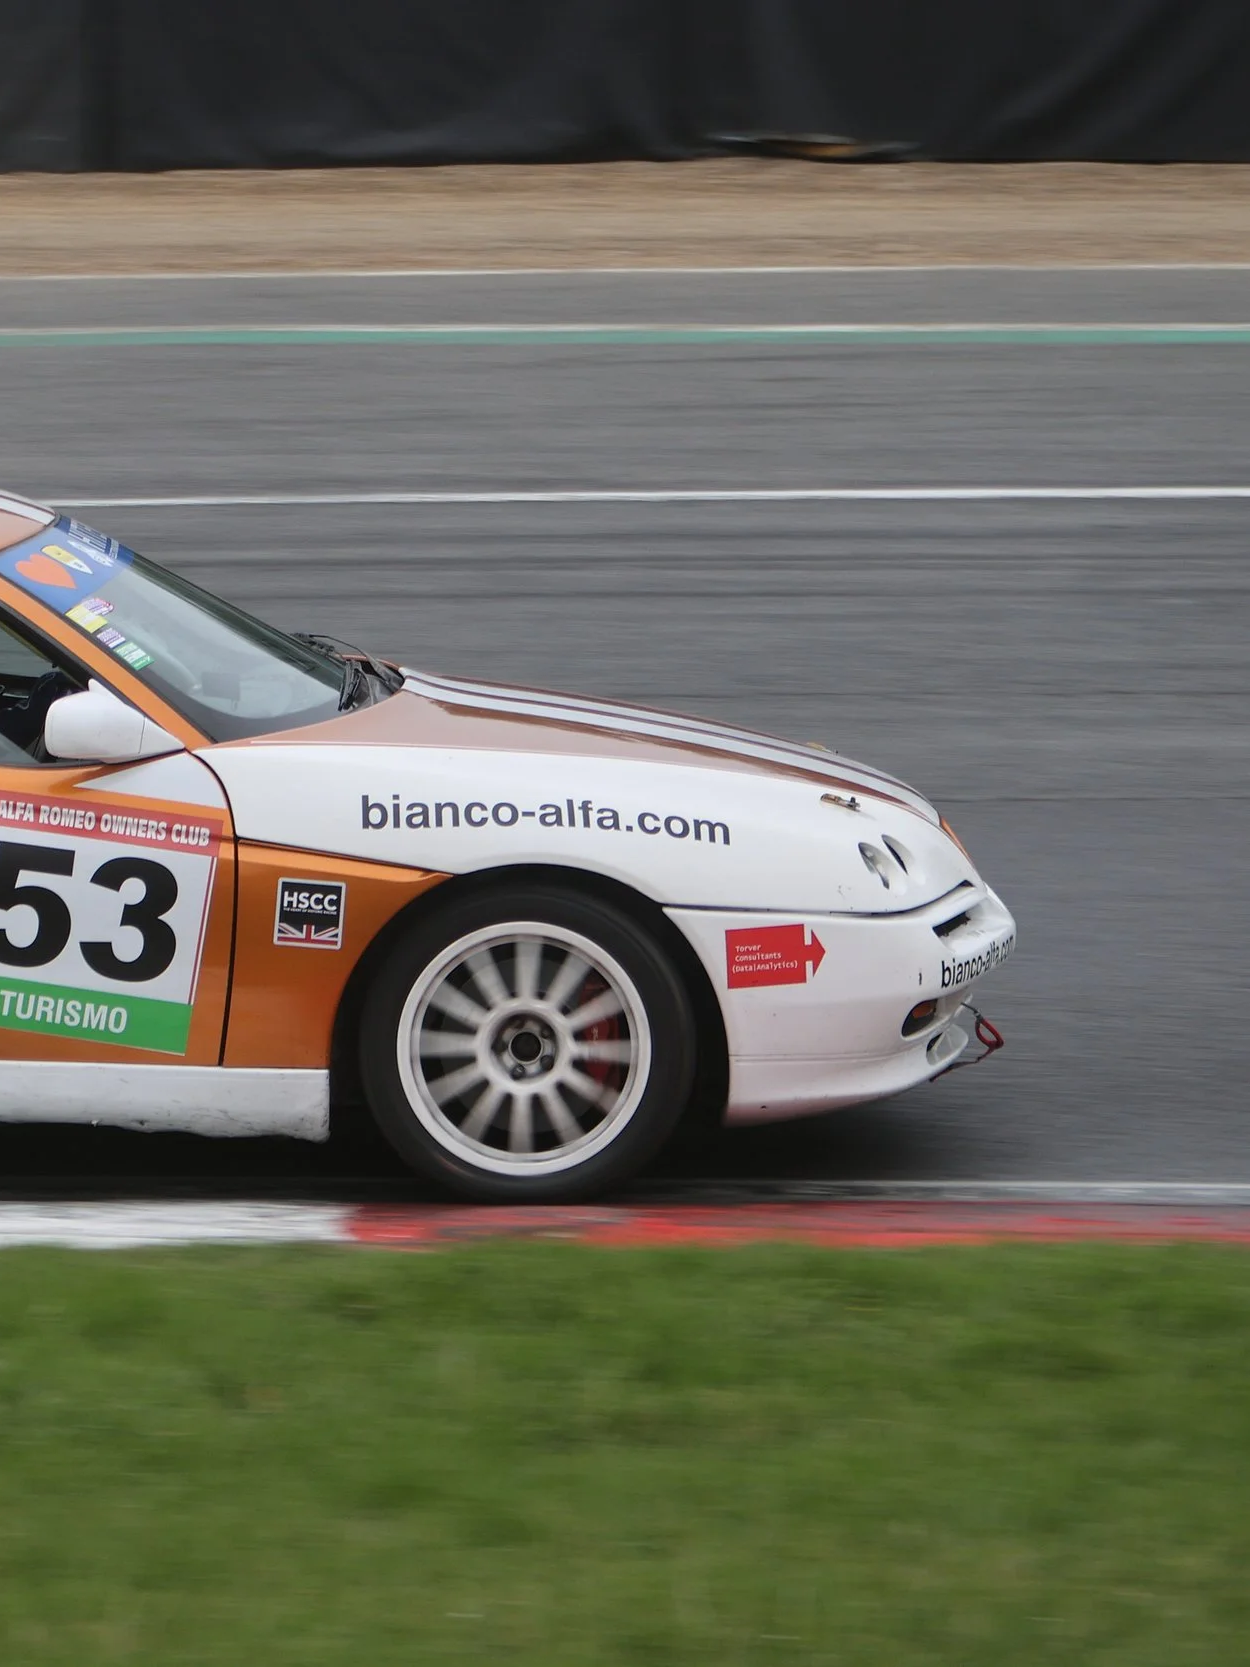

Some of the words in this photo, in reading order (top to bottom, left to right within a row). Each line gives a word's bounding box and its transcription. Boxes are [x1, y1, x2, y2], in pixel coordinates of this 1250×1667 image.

[38, 805, 95, 831] ROMEO
[100, 814, 166, 841] OWNERS
[171, 824, 210, 847] CLUB
[361, 794, 731, 845] bianco-alfa.com
[283, 890, 338, 911] HSCC
[734, 952, 782, 962] Consultants
[0, 989, 128, 1034] TURISMO
